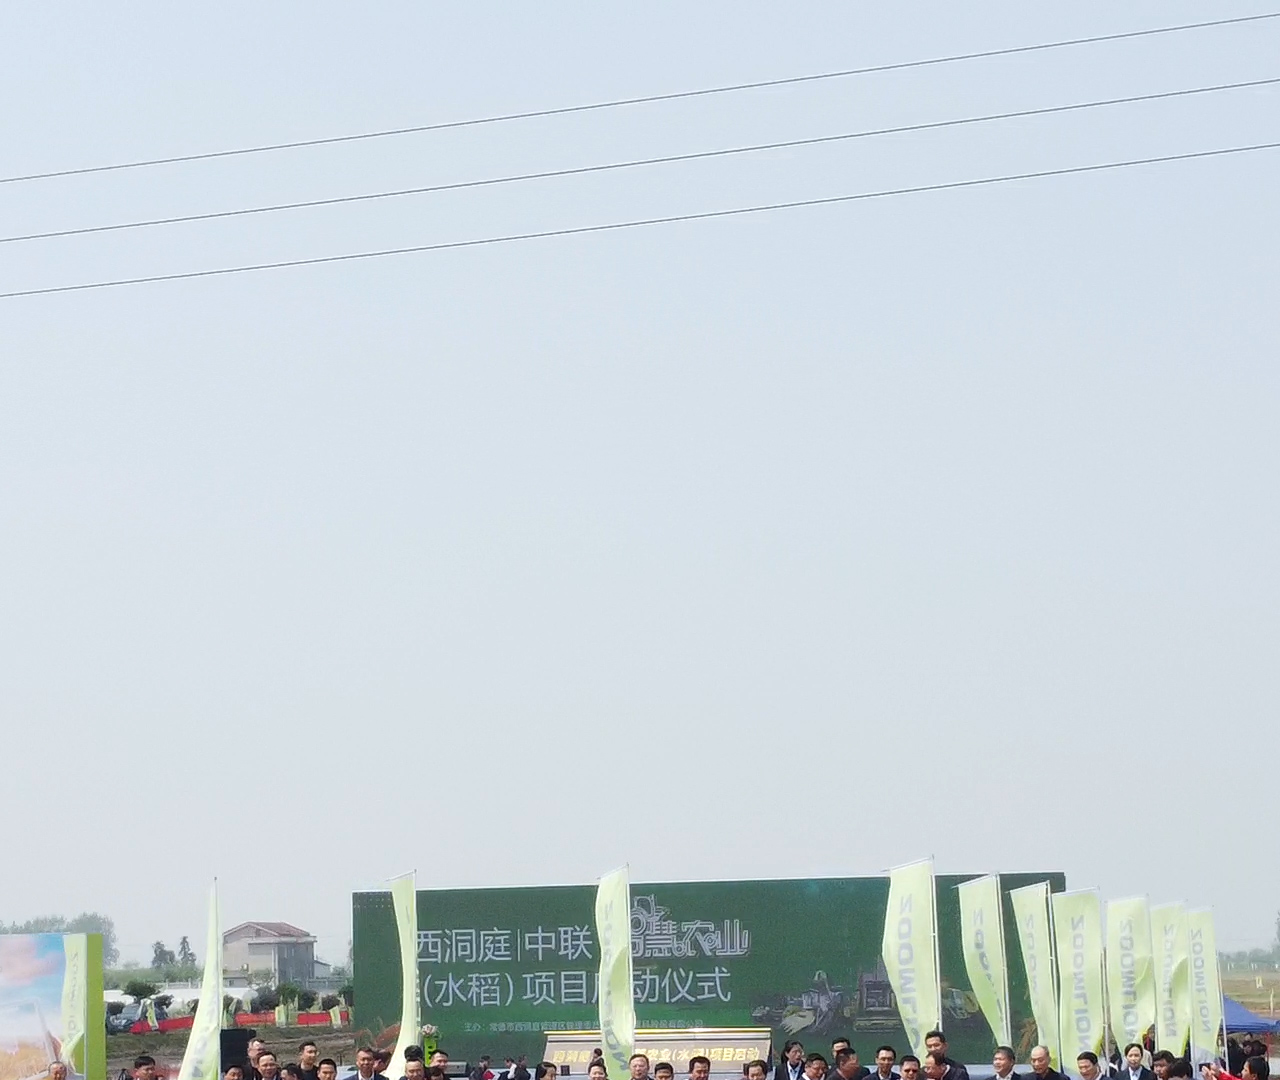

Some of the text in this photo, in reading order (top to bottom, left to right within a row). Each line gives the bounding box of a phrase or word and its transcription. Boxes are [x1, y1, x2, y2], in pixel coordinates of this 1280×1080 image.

[423, 965, 732, 1006] (水稻)项目动仪式
